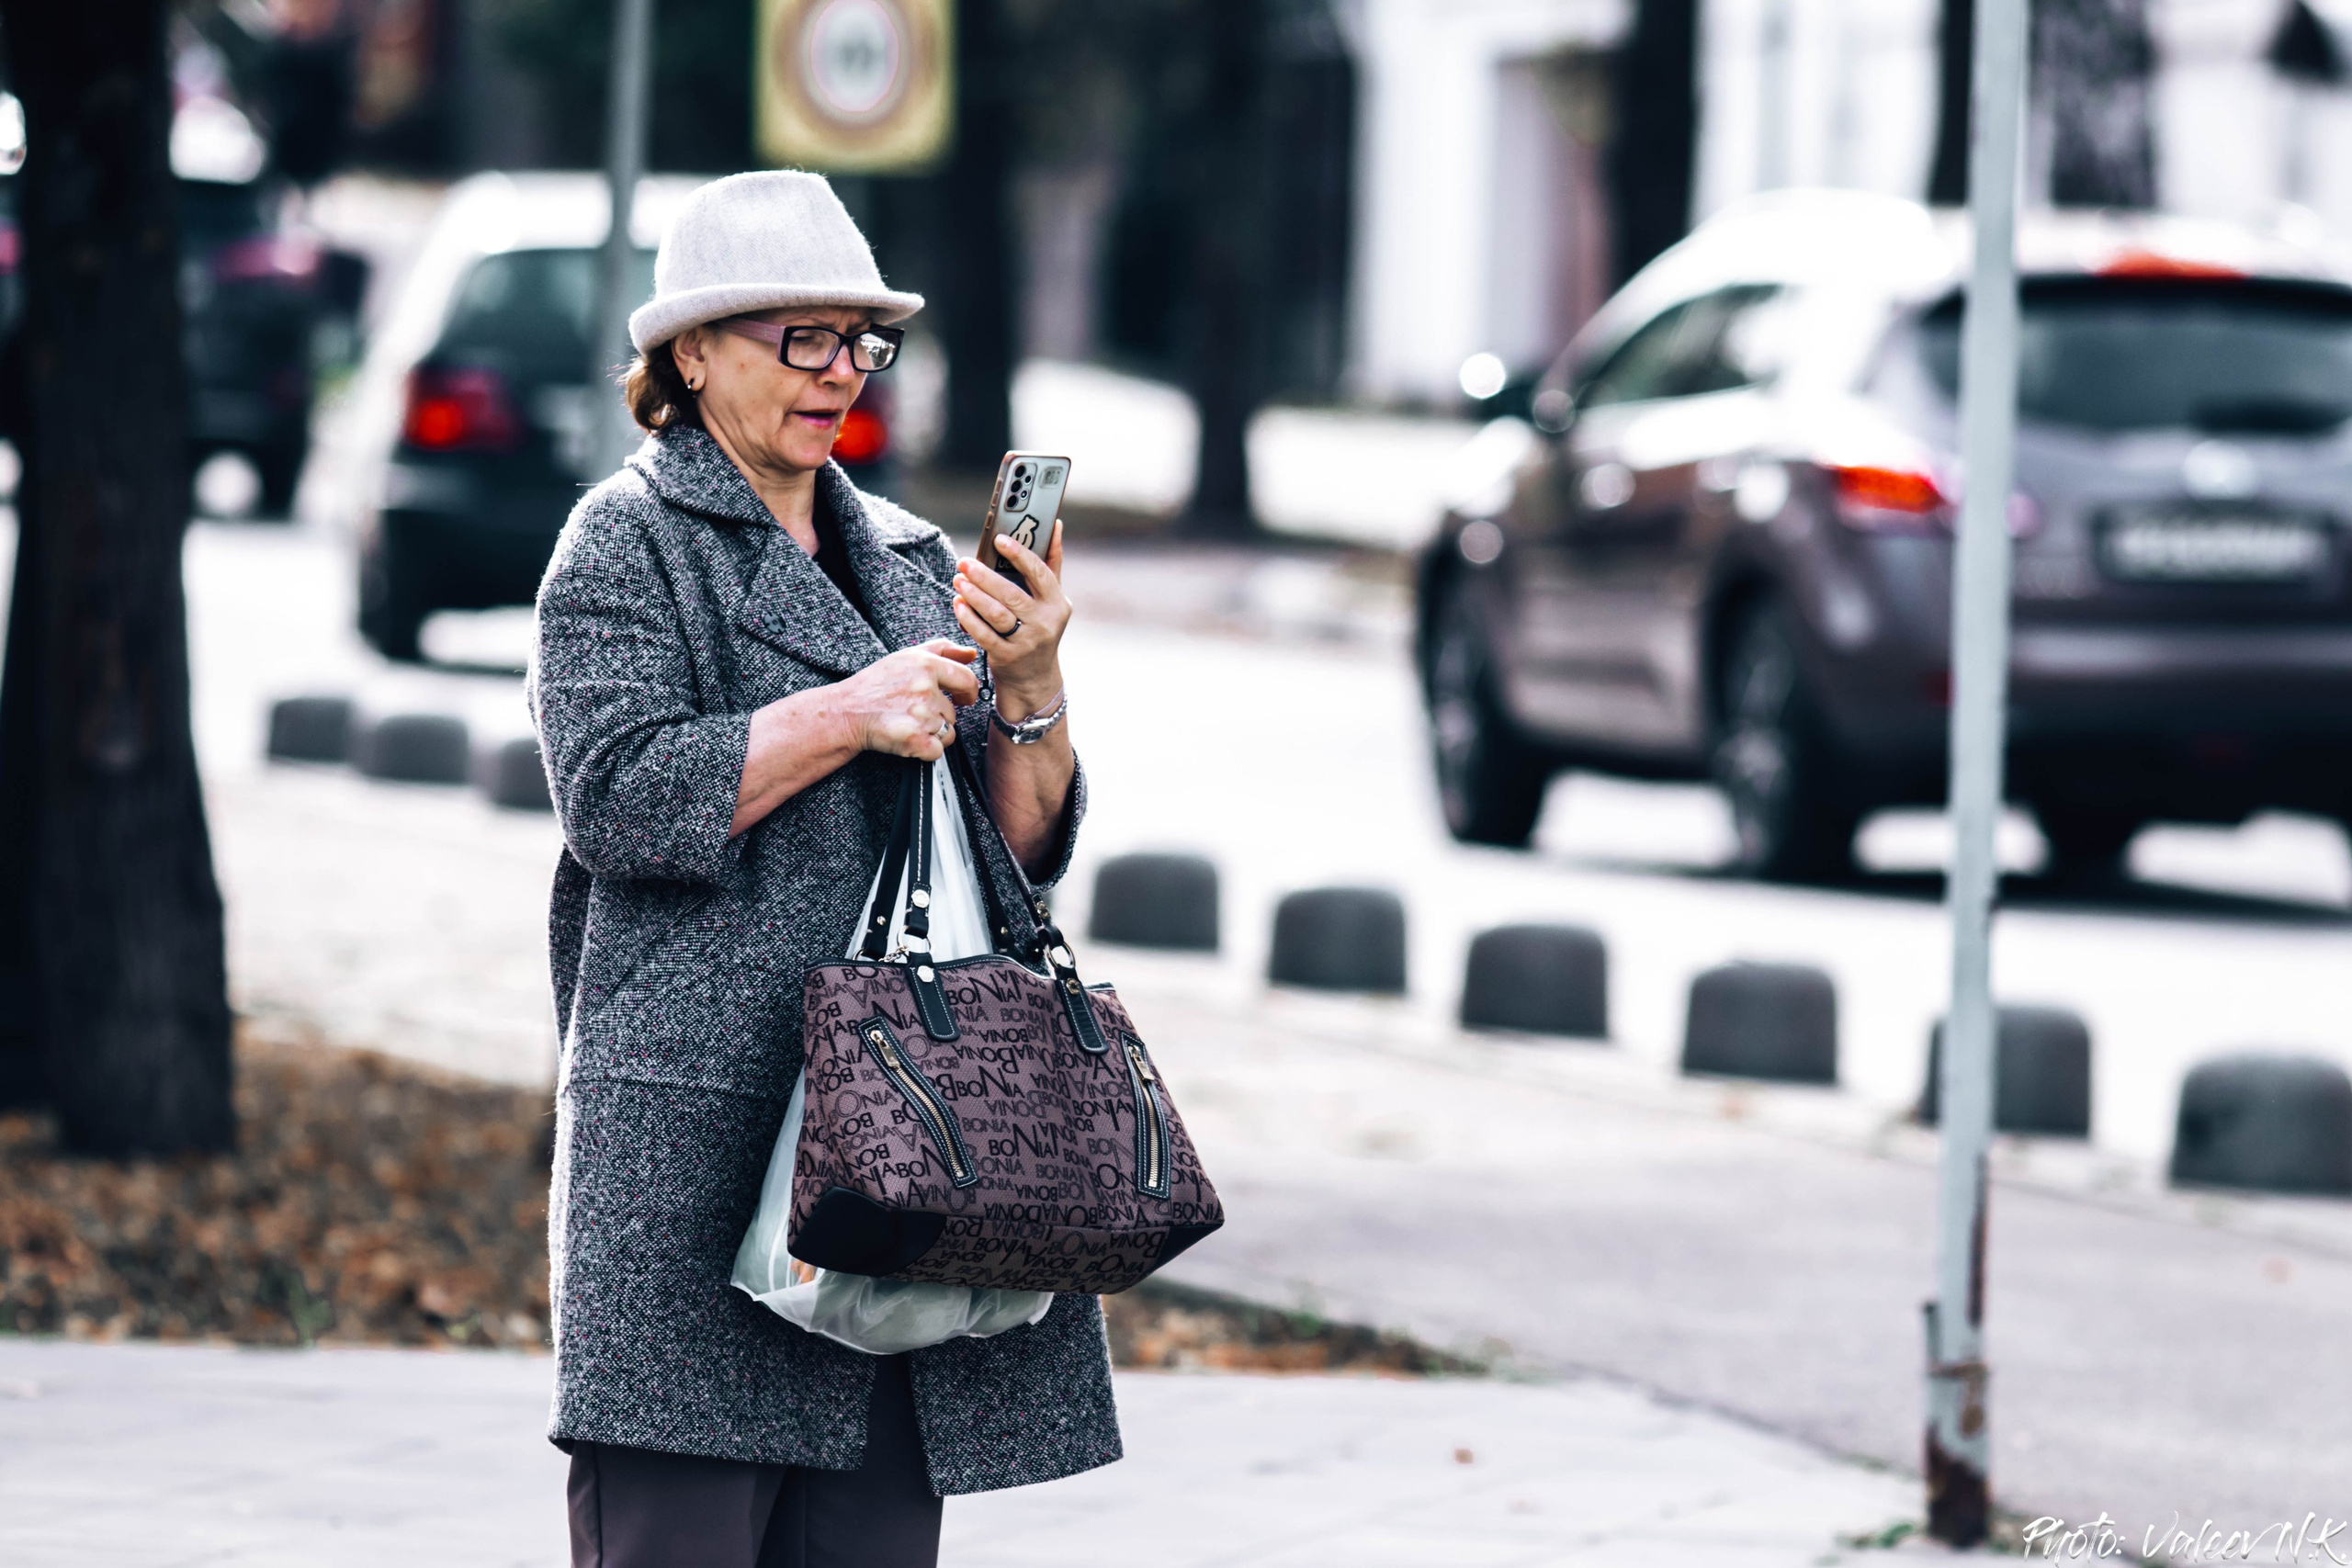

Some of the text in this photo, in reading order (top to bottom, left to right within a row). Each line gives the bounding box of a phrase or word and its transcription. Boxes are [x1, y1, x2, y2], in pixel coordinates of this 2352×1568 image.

[946, 974, 1019, 1005] BONIA
[978, 1028, 1029, 1043] BONIA
[956, 1065, 1025, 1099] BONIA
[989, 1122, 1055, 1158] BONIA
[1014, 1184, 1057, 1202] BONIA
